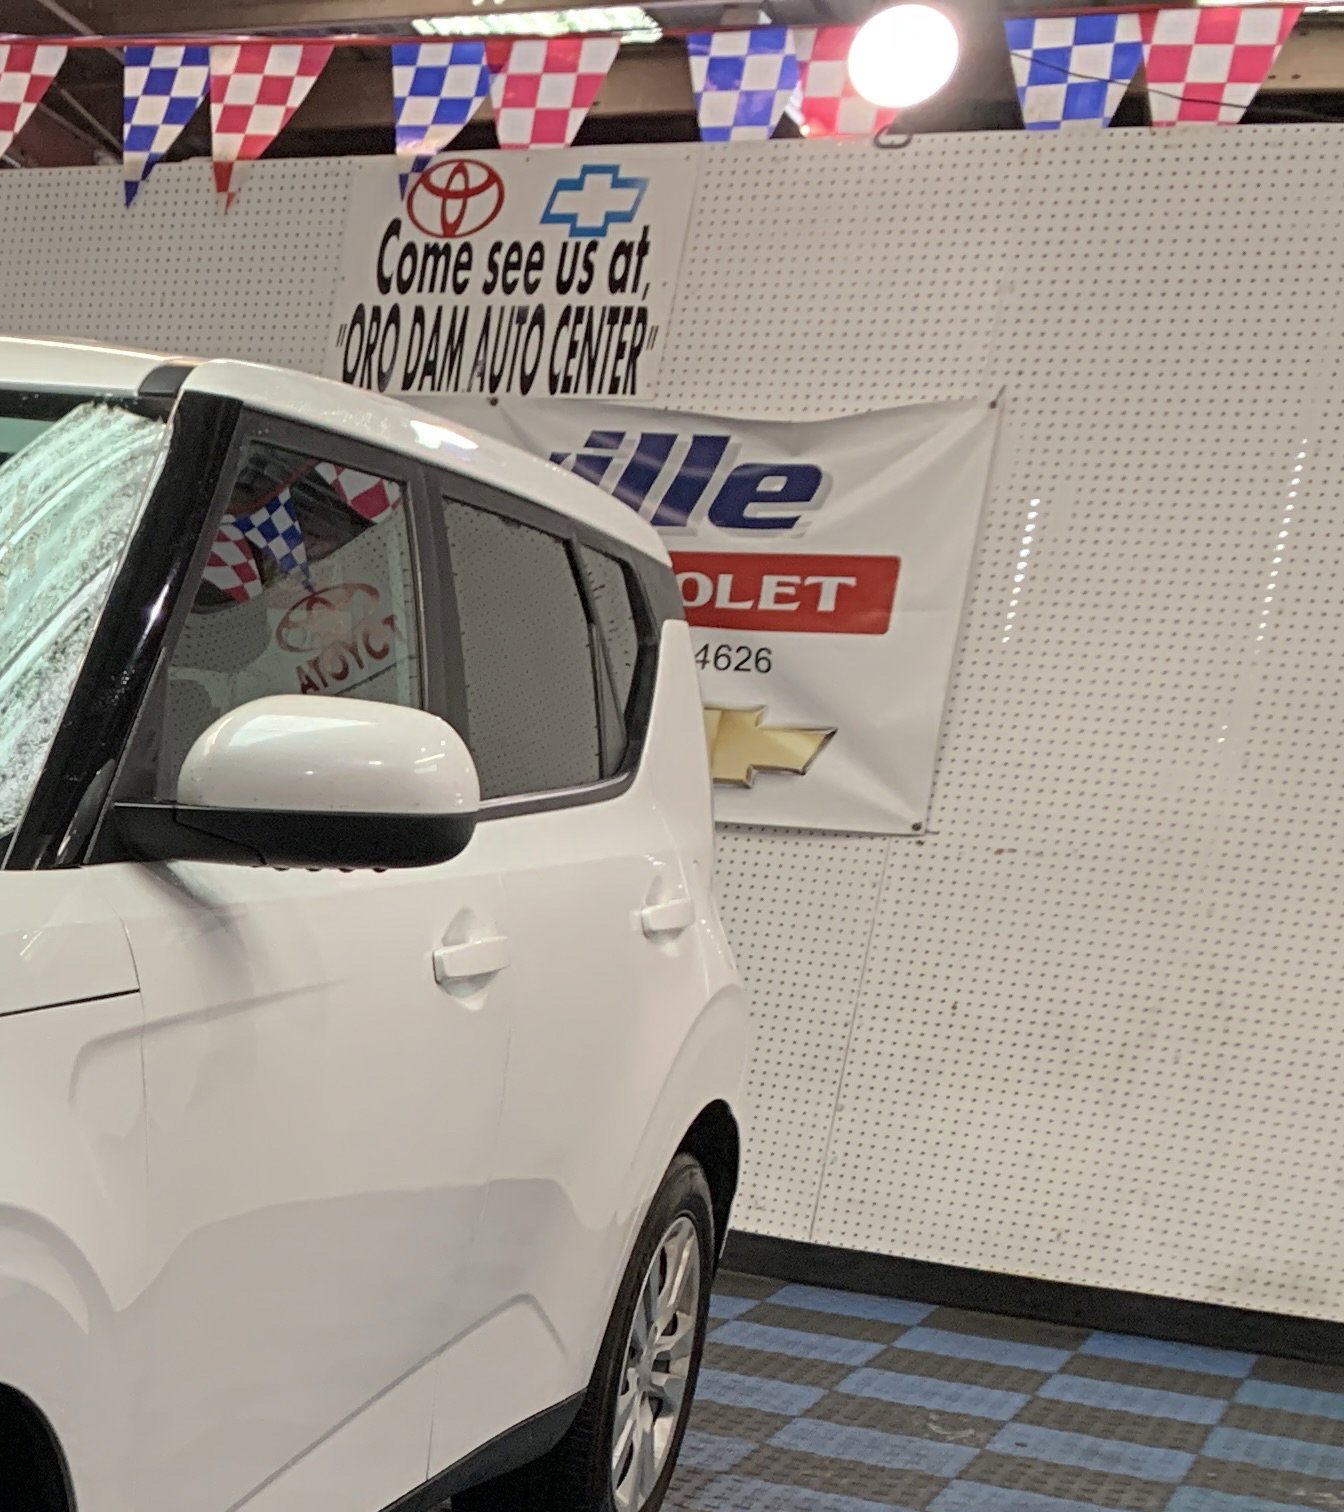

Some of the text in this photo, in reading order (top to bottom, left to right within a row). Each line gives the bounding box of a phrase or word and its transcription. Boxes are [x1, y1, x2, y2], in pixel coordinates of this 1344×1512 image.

[376, 217, 651, 302] Come see us at,
[400, 304, 470, 392] DAM
[467, 302, 546, 396] AUTO
[548, 303, 659, 396] CENTER"
